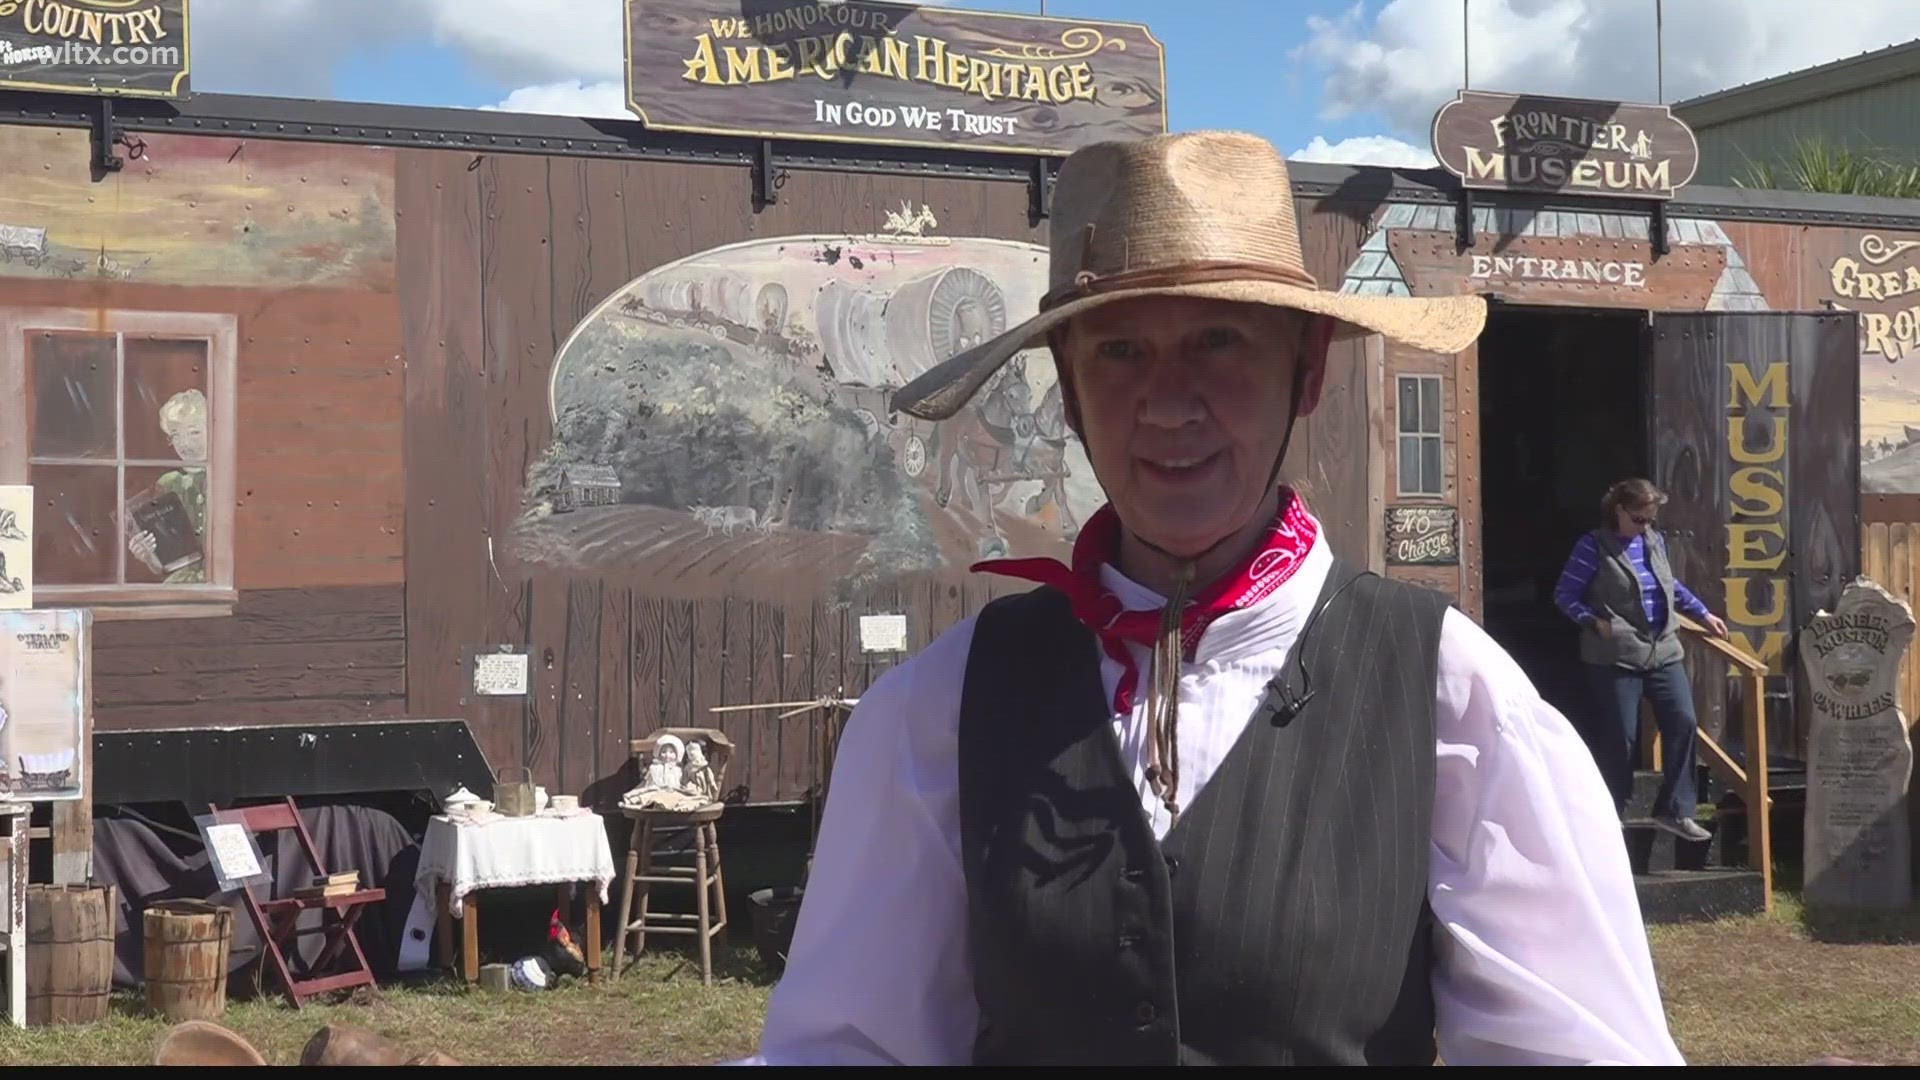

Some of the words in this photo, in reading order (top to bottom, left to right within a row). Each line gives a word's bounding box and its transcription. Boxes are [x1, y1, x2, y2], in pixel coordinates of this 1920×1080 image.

[24, 0, 167, 45] COUNTRY
[710, 17, 751, 39] WE
[756, 5, 836, 35] HONOR
[837, 5, 898, 35] OUR
[681, 29, 910, 86] AMERICAN
[914, 35, 1097, 102] HERITAGE
[815, 100, 842, 125] IN
[846, 102, 896, 128] GOD
[899, 106, 942, 131] WE
[946, 109, 1018, 135] TRUST
[1490, 111, 1632, 153] FRONTIER
[1462, 146, 1671, 190] MUSEUM
[1470, 255, 1646, 287] ENTRANCE
[1396, 516, 1430, 534] NO
[1720, 361, 1791, 677] MUSEUM
[1399, 533, 1450, 560] Charge
[1809, 614, 1889, 639] PIONEER
[1814, 630, 1888, 658] MUSEUM
